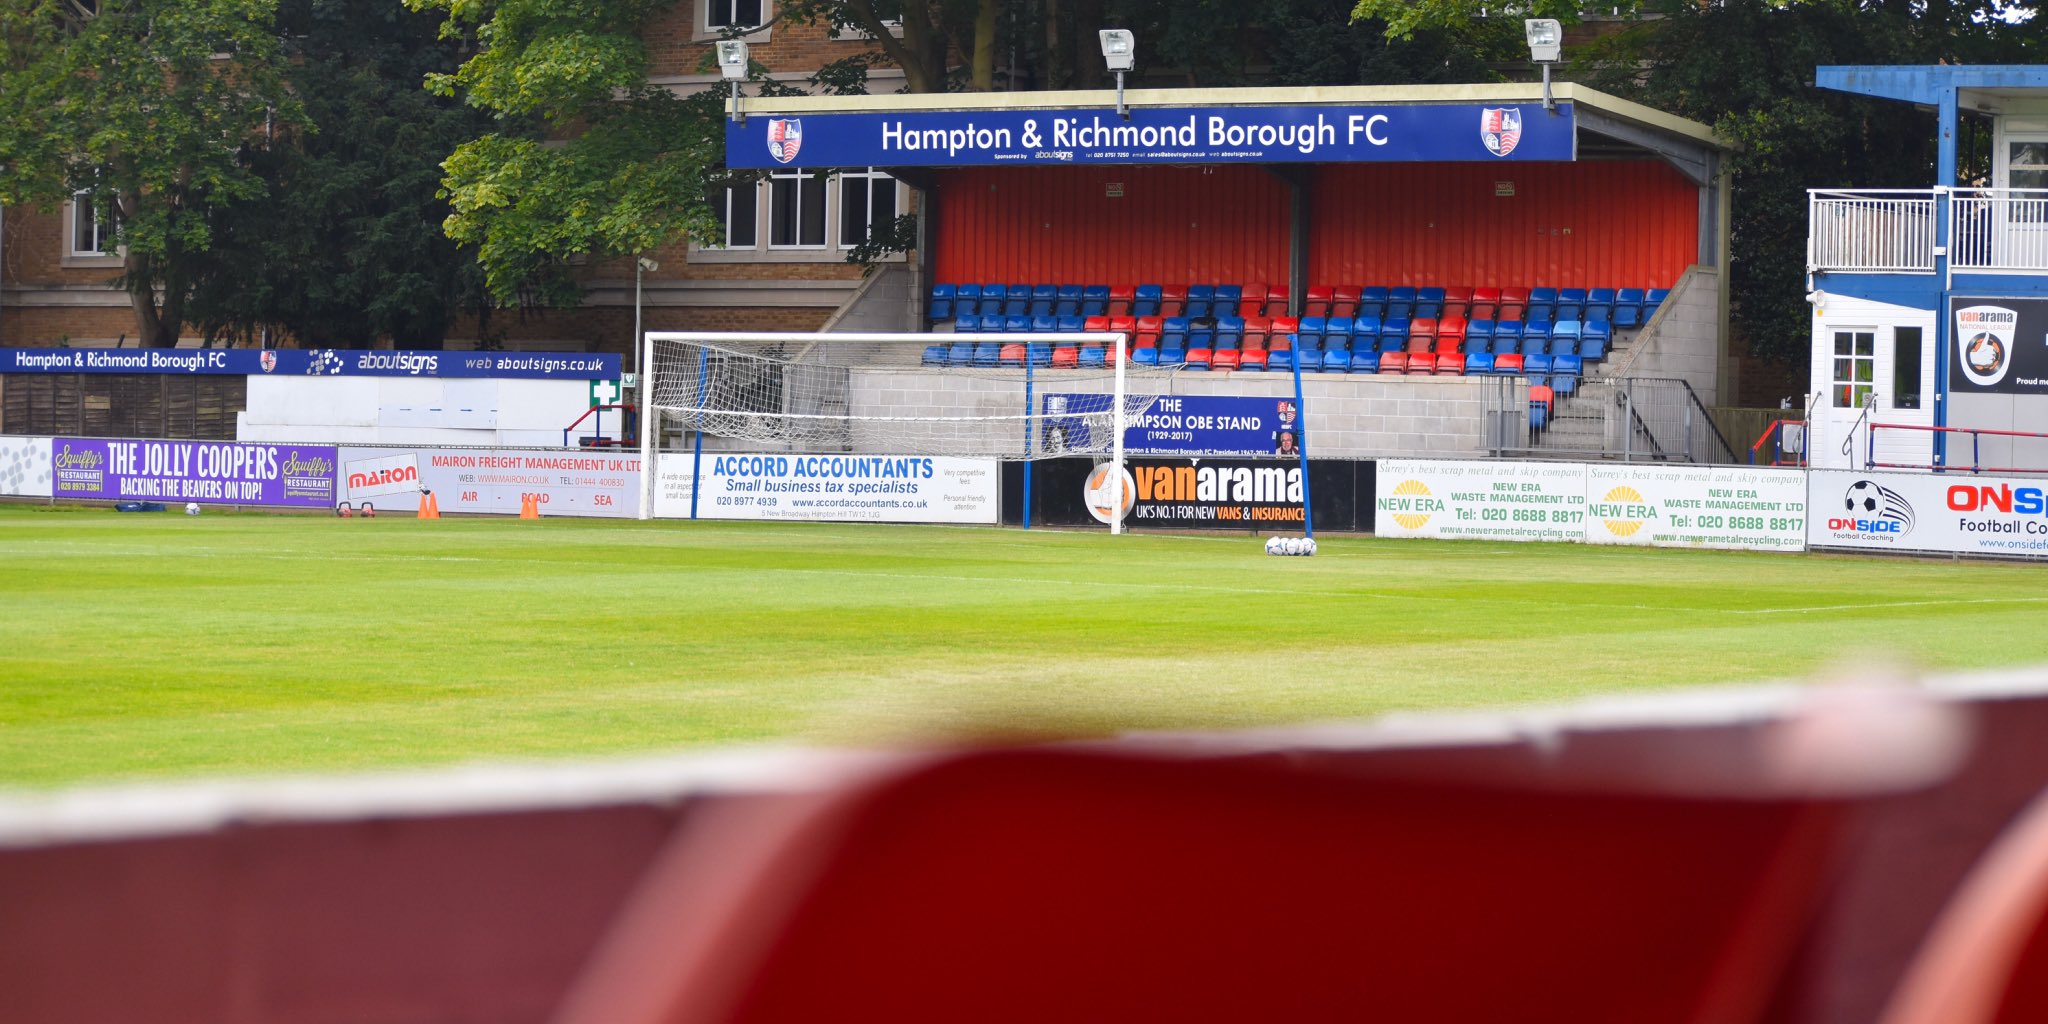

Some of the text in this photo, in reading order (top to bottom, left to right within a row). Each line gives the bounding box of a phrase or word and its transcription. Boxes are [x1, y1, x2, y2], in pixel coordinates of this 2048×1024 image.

[882, 114, 1389, 157] Hampton & Richmond Borough FC
[1035, 149, 1073, 160] aboutsigns
[1960, 311, 2013, 322] vanarama
[16, 352, 226, 371] Hampton & Richmond Borough FC
[358, 352, 438, 374] aboutsigns
[465, 357, 604, 373] web aboutsigns.co.uk
[2016, 377, 2038, 385] Proud
[1159, 399, 1182, 412] THE
[1185, 416, 1213, 430] OBE
[1217, 416, 1261, 430] STAND
[1147, 431, 1192, 442] (1929-2017)
[55, 444, 104, 469] Squiffy's
[107, 443, 278, 480] THE JOLLY COOPERS
[282, 451, 333, 476] Squiffy's
[431, 456, 475, 468] MAIRON
[479, 456, 522, 469] FREIGHT
[525, 457, 605, 471] MANAGEMENT
[608, 460, 623, 471] UK
[713, 456, 933, 479] ACCORD ACCOUNTANTS
[944, 469, 955, 477] Very
[1379, 463, 1583, 478] Surrey's best scrap metal and skip company
[60, 471, 100, 480] RESTAURANT
[459, 474, 624, 487] WEB: WWW.MAIRON.CO.UK TEL: 01444 400830
[1591, 468, 1805, 486] Surrey's best scrap metal and skip company
[60, 482, 71, 490] 020
[72, 483, 85, 491] 8979
[120, 477, 262, 500] BACKING THE BEAVERS ON TOP!
[287, 479, 330, 488] RESTAURANT
[726, 479, 918, 495] Small business tax specialists
[1135, 467, 1303, 502] vanarama
[1493, 483, 1541, 492] NEW ERA
[461, 491, 478, 501] AIR
[594, 495, 612, 506] SEA
[1451, 492, 1585, 504] WASTE MANAGEMENT LTD
[1708, 489, 1758, 499] NEW ERA
[717, 497, 928, 509] 020 8977 4939 www.accordaccountants.co.uk
[1378, 498, 1445, 512] NEW ERA
[1664, 499, 1804, 511] WASTE MANAGEMENT LTD
[781, 510, 810, 518] Broadway
[1136, 505, 1305, 521] UK'S NO.1 FOR NEW VANS & INSURANCE
[1455, 508, 1584, 523] Tel: 020 8688 8817
[1589, 504, 1658, 519] NEW ERA
[1669, 515, 1804, 531] Tel: 020 8688 8817
[1828, 518, 1900, 533] ONSIDE
[1960, 518, 2048, 534] Football Co
[1652, 534, 1803, 546] www.newerametalrecycling.com
[1862, 533, 1894, 542] Coaching
